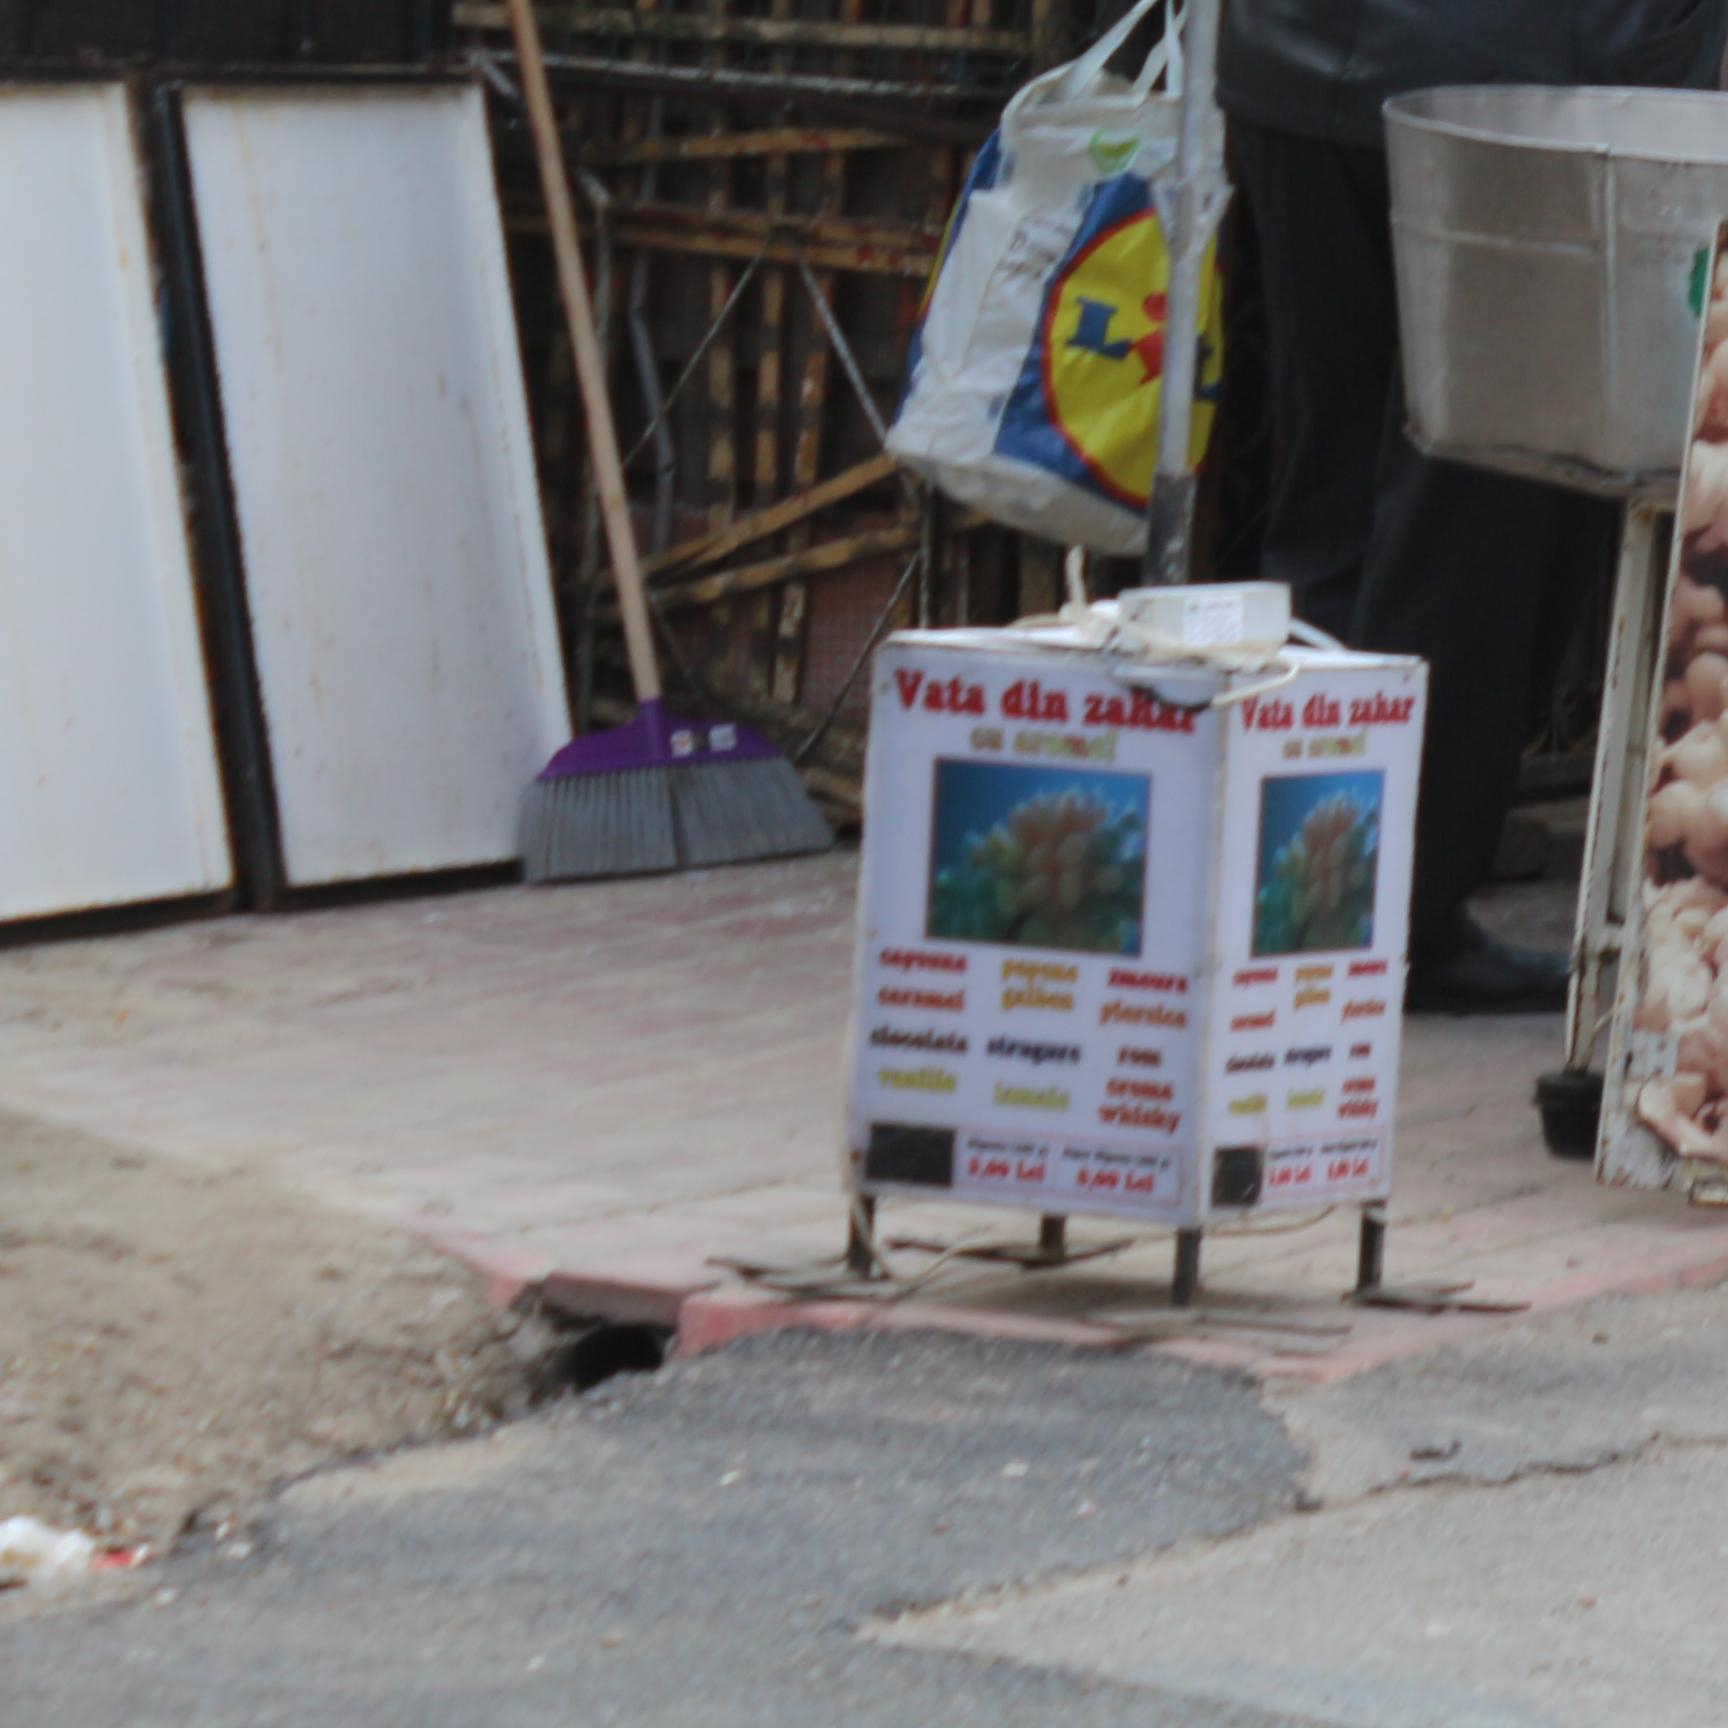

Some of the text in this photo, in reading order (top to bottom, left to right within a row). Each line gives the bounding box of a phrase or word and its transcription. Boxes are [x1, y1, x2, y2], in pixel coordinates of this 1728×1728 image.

[894, 669, 1197, 734] Vata din zahar
[1241, 688, 1416, 733] Vata din zahar
[877, 987, 967, 1013] caramel
